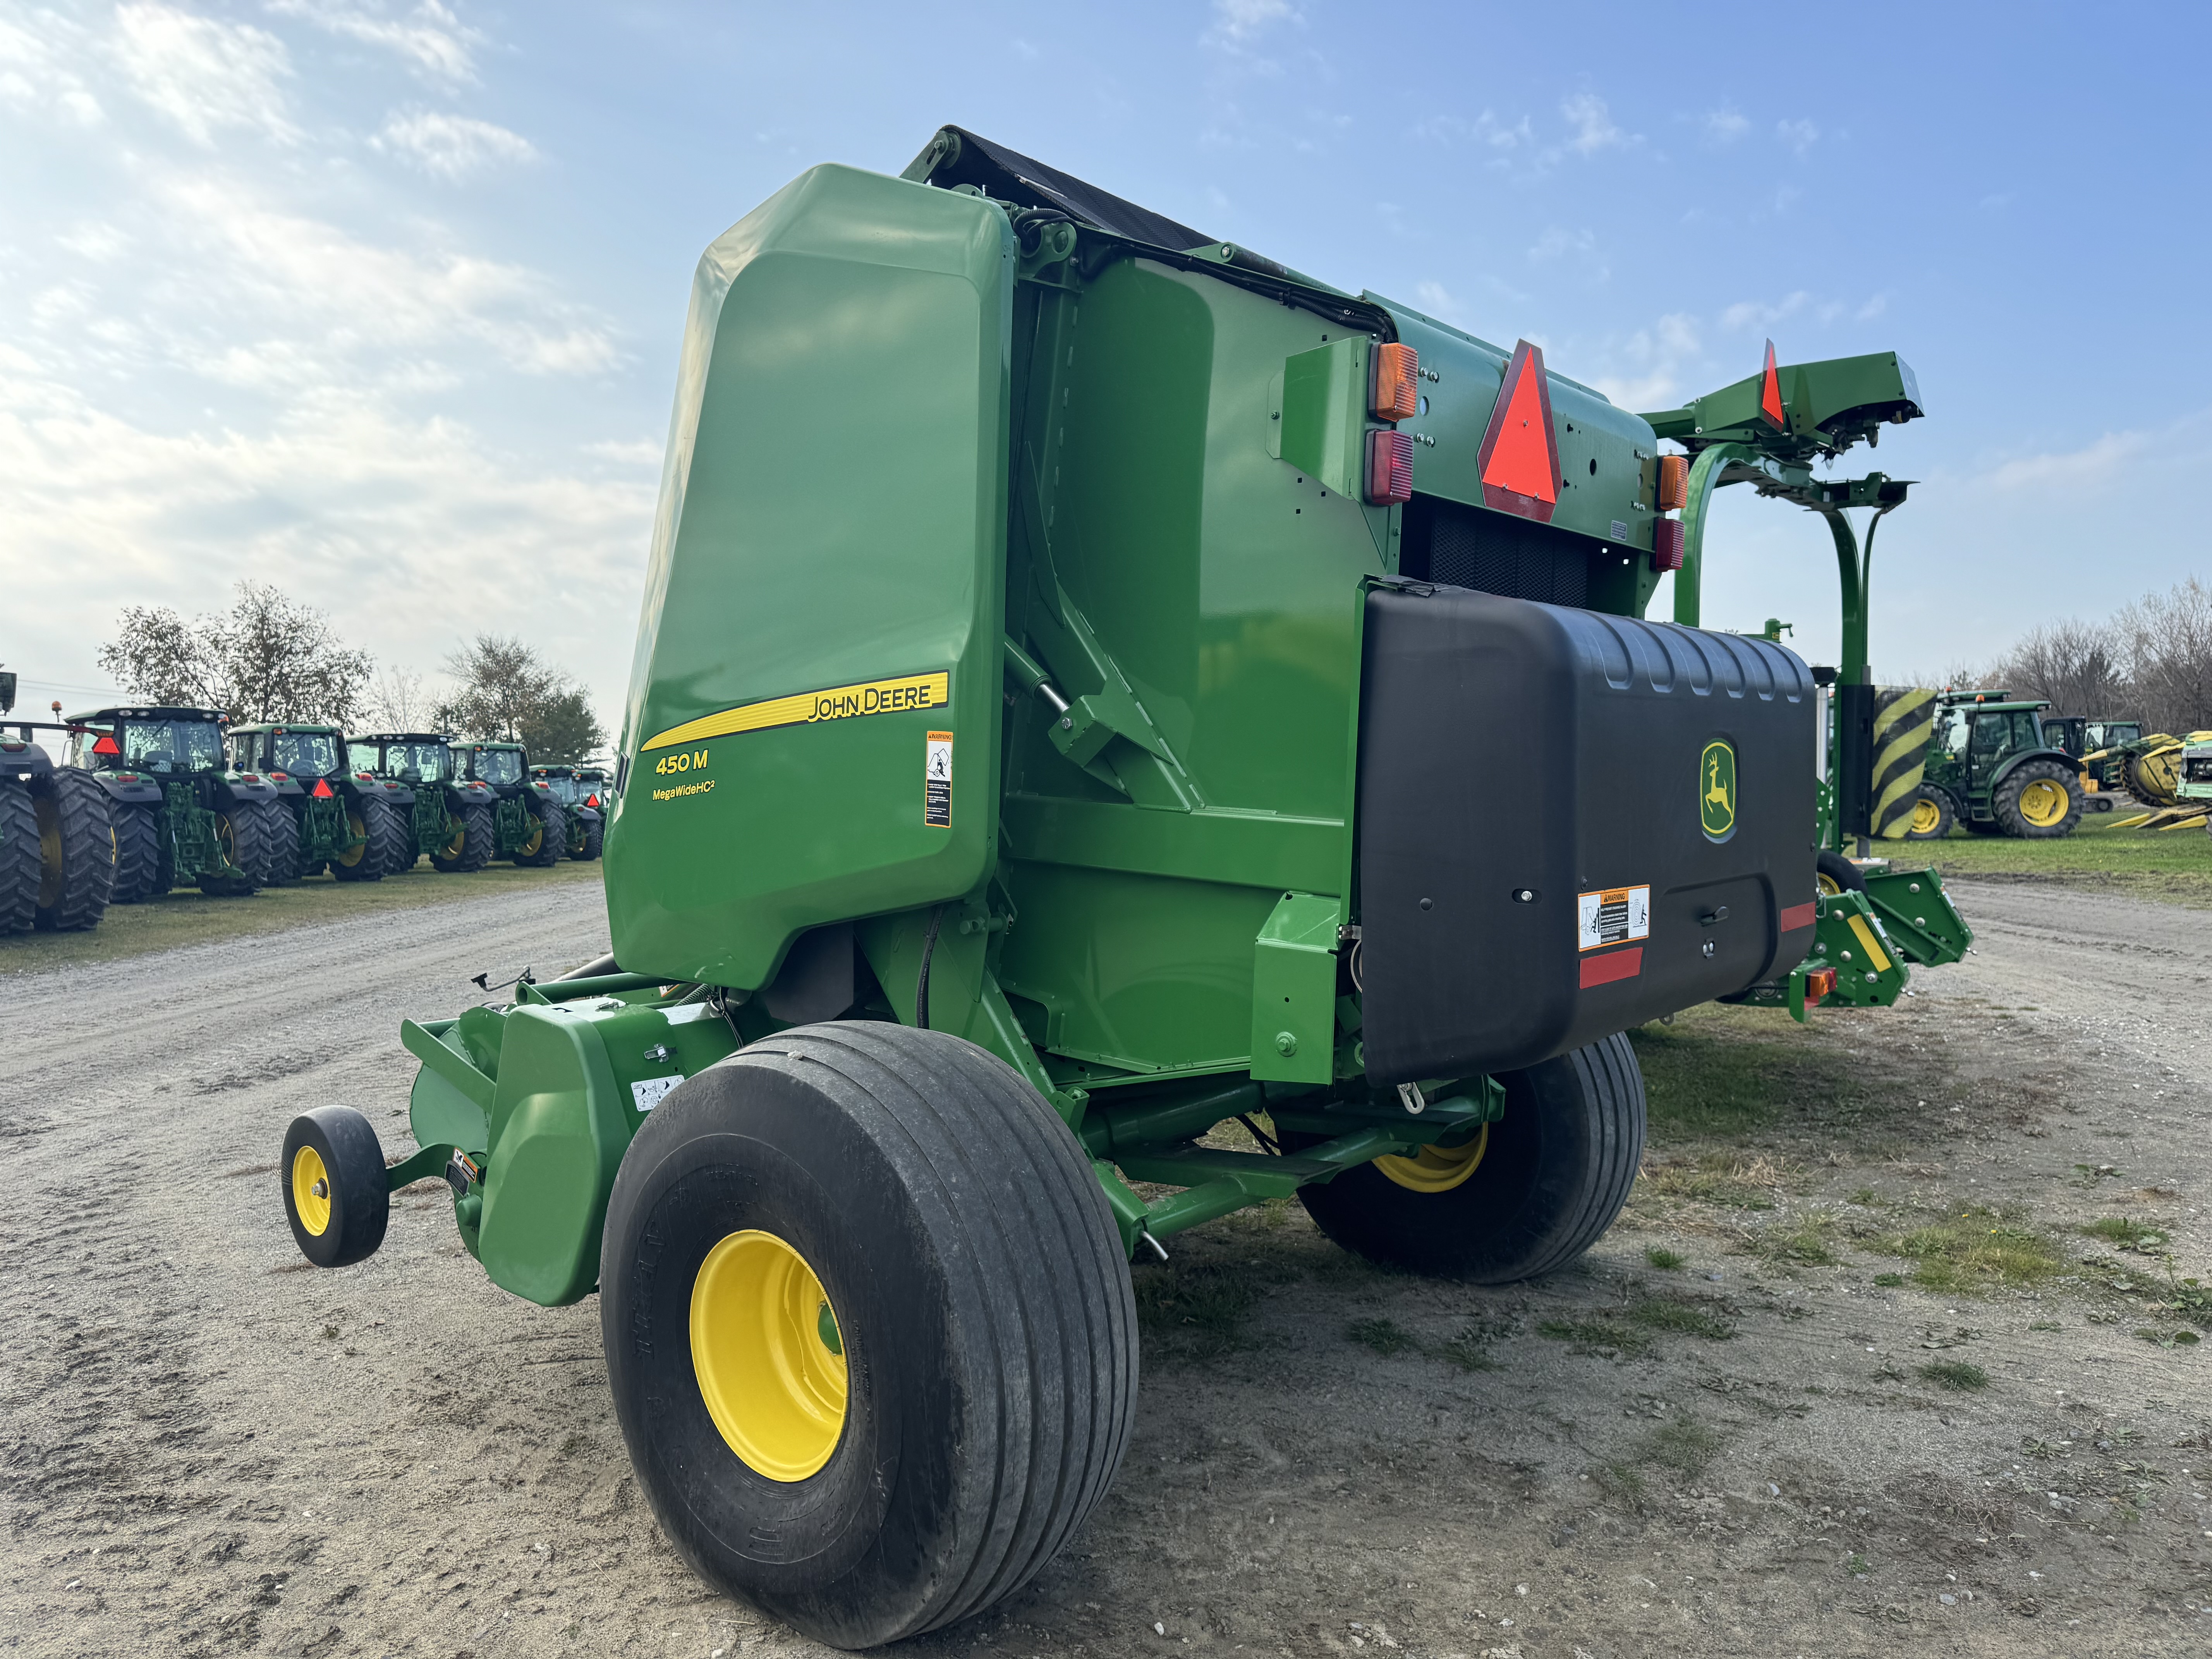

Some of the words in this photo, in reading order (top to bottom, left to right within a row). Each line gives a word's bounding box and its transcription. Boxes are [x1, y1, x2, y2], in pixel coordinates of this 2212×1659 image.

[808, 694, 859, 719] JOHN
[864, 685, 931, 711] DEERE
[656, 753, 690, 775] 450
[693, 749, 708, 769] M
